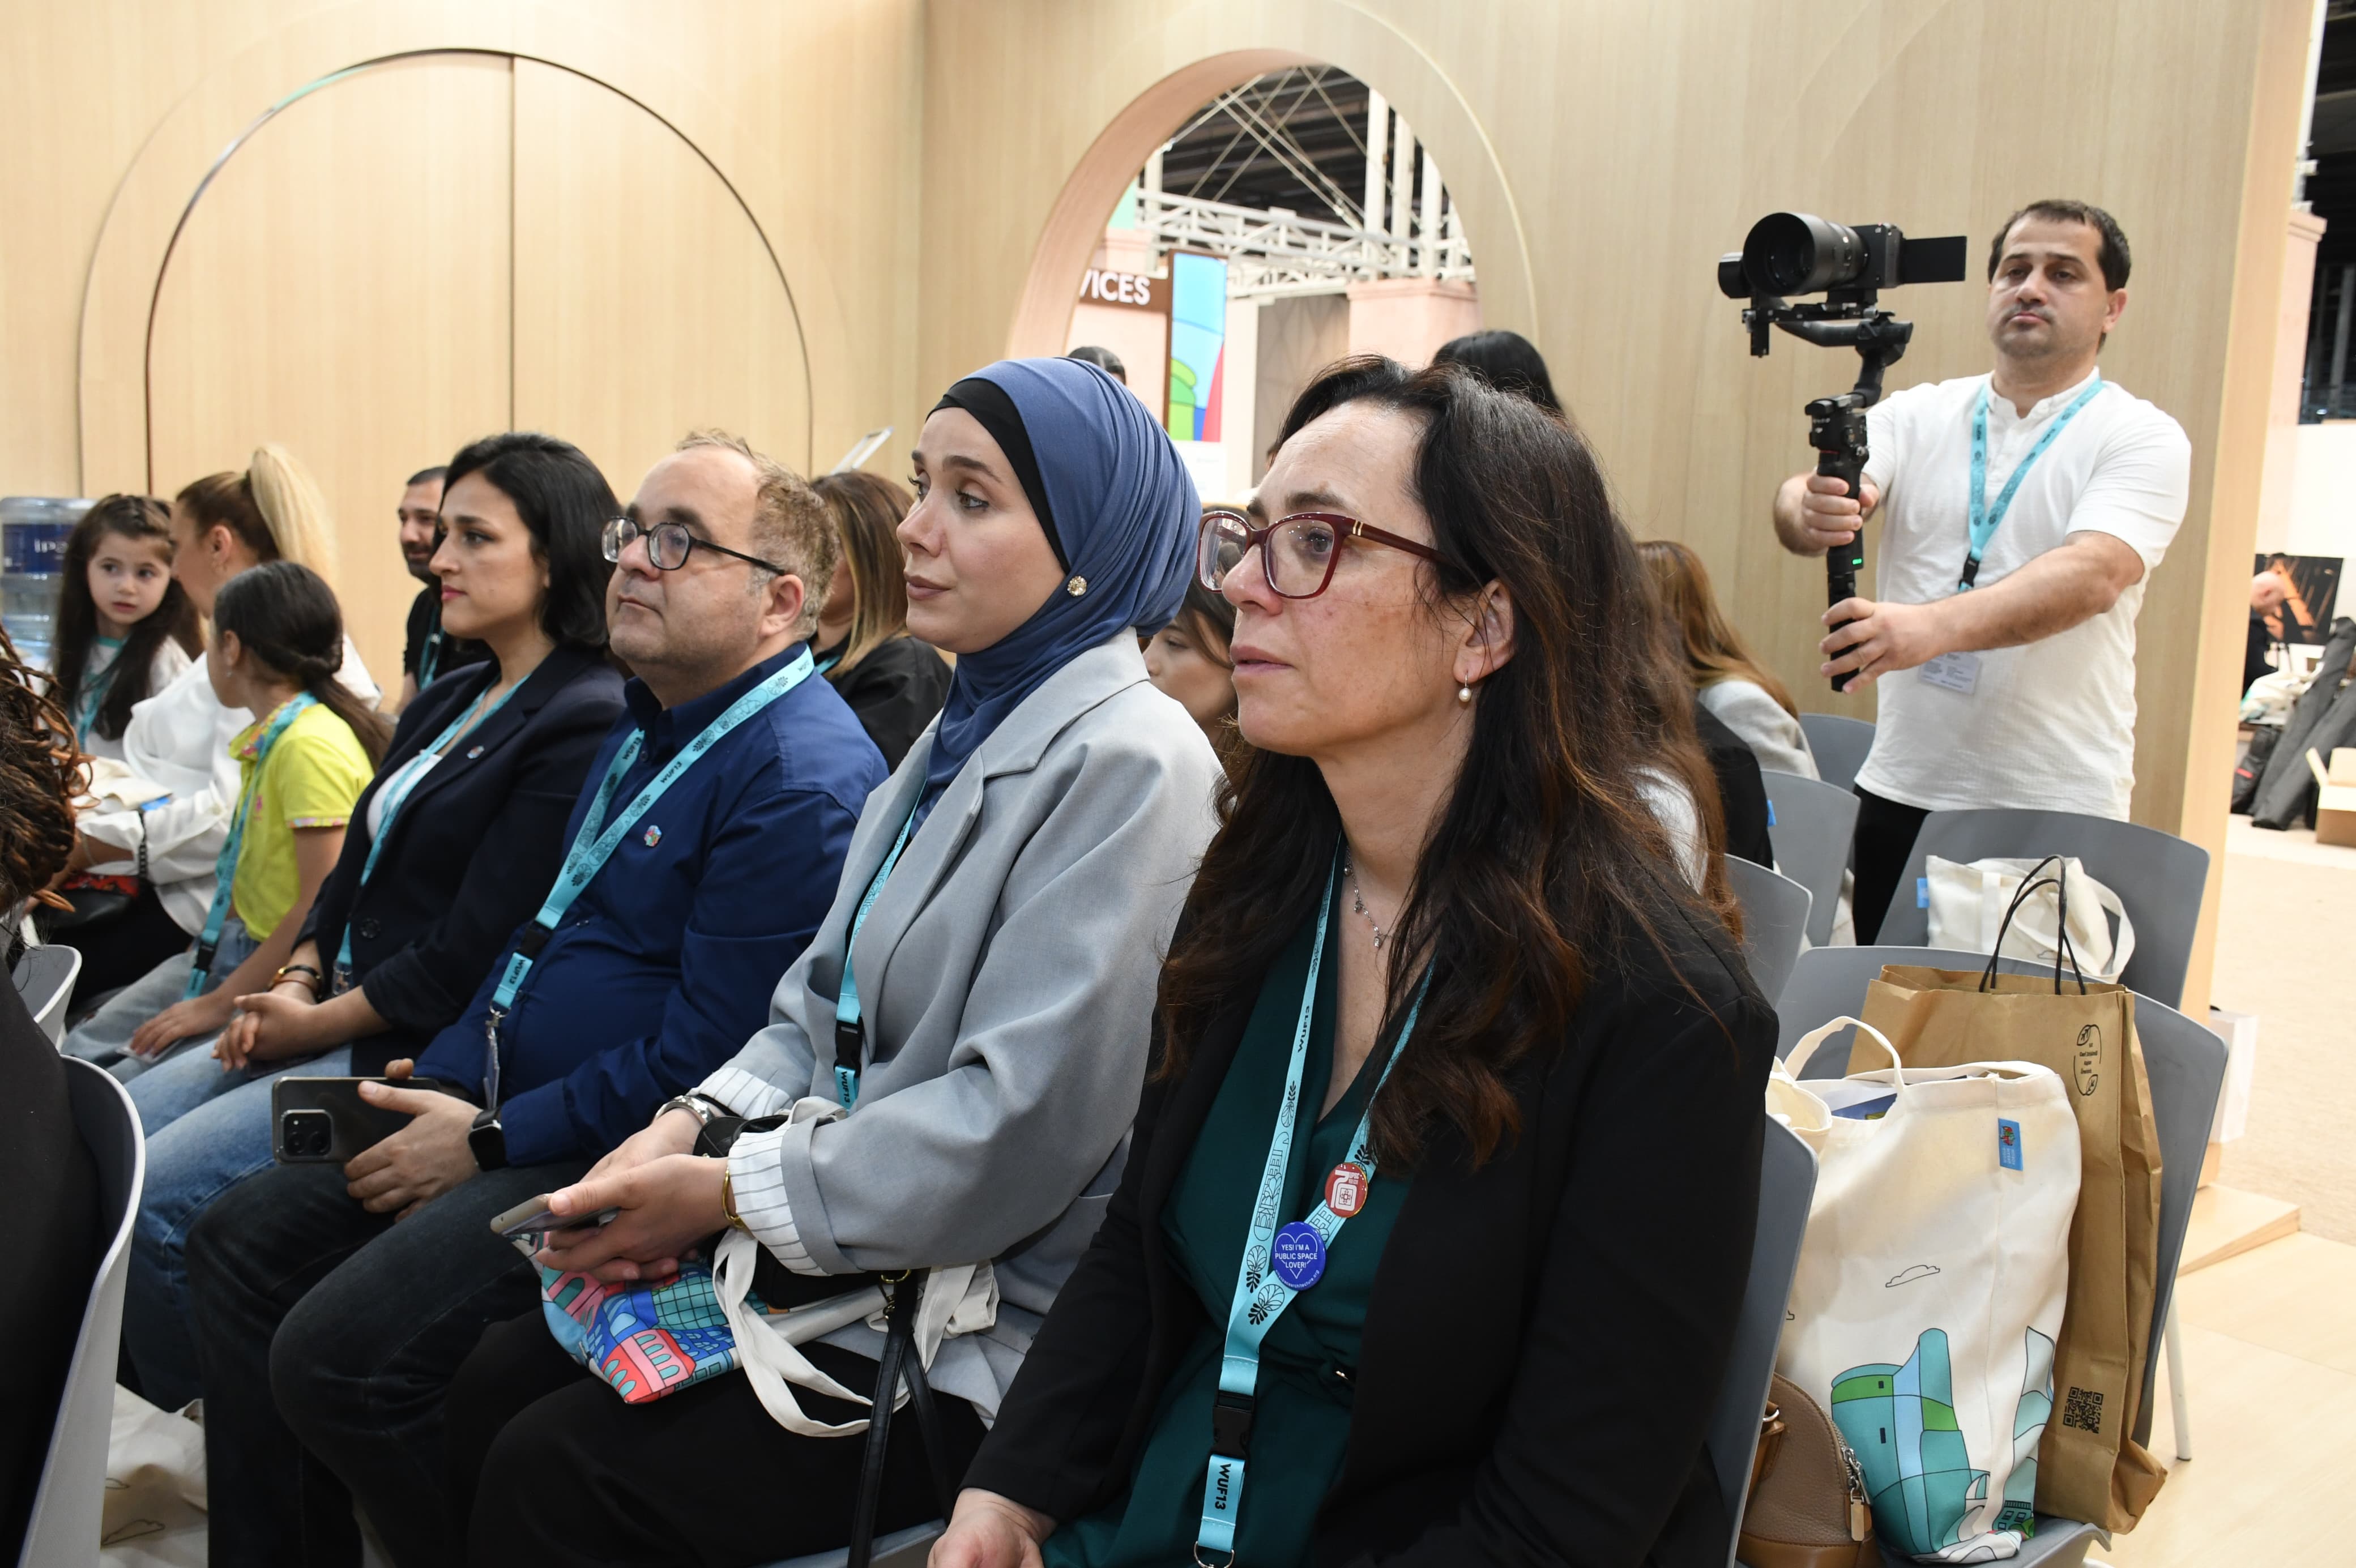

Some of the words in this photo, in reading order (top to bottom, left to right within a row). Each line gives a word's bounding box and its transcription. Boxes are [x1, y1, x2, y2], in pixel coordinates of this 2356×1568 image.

[660, 761, 682, 783] WUF13
[509, 959, 526, 984] WUF13
[1297, 1005, 1309, 1053] WUF13
[840, 1071, 851, 1103] WUF13
[1214, 1463, 1231, 1510] WUF13
